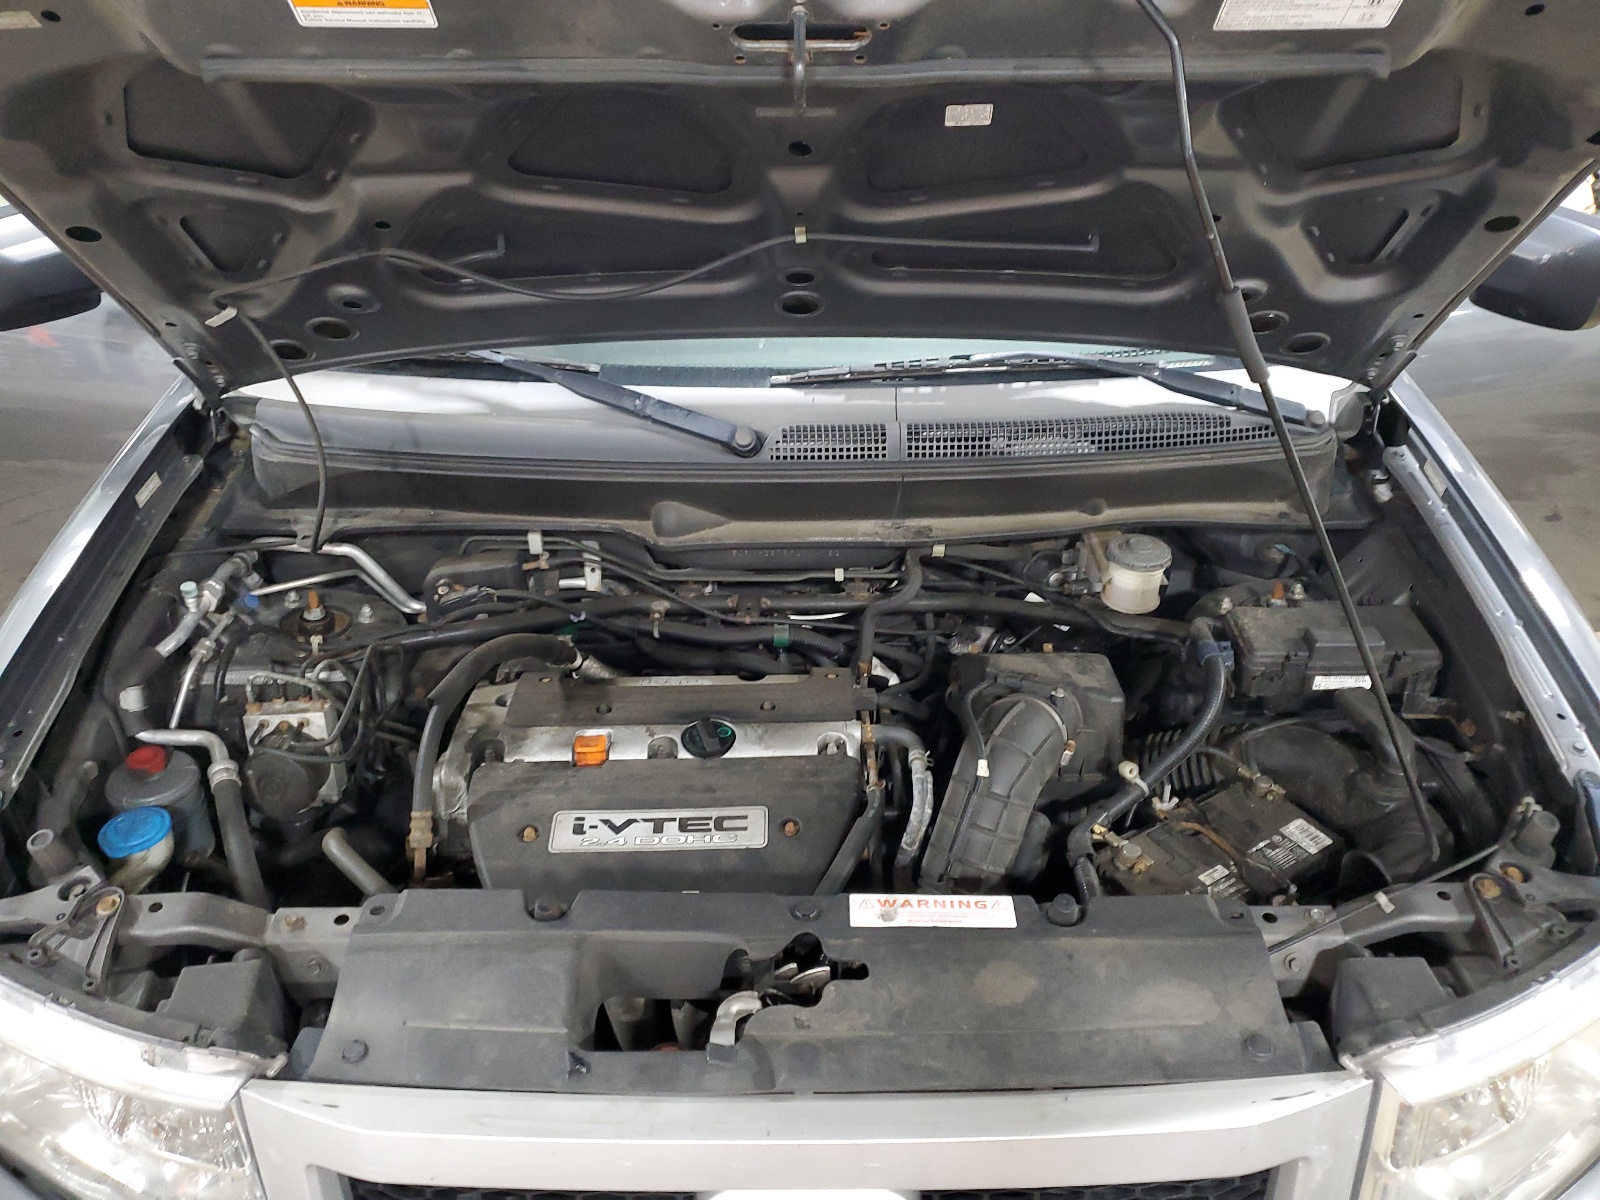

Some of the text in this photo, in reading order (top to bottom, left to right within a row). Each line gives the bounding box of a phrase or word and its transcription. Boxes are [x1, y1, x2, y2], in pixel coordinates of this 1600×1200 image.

[572, 815, 748, 836] i-VTEC
[634, 834, 738, 846] DOHC
[877, 898, 988, 910] WARNING
